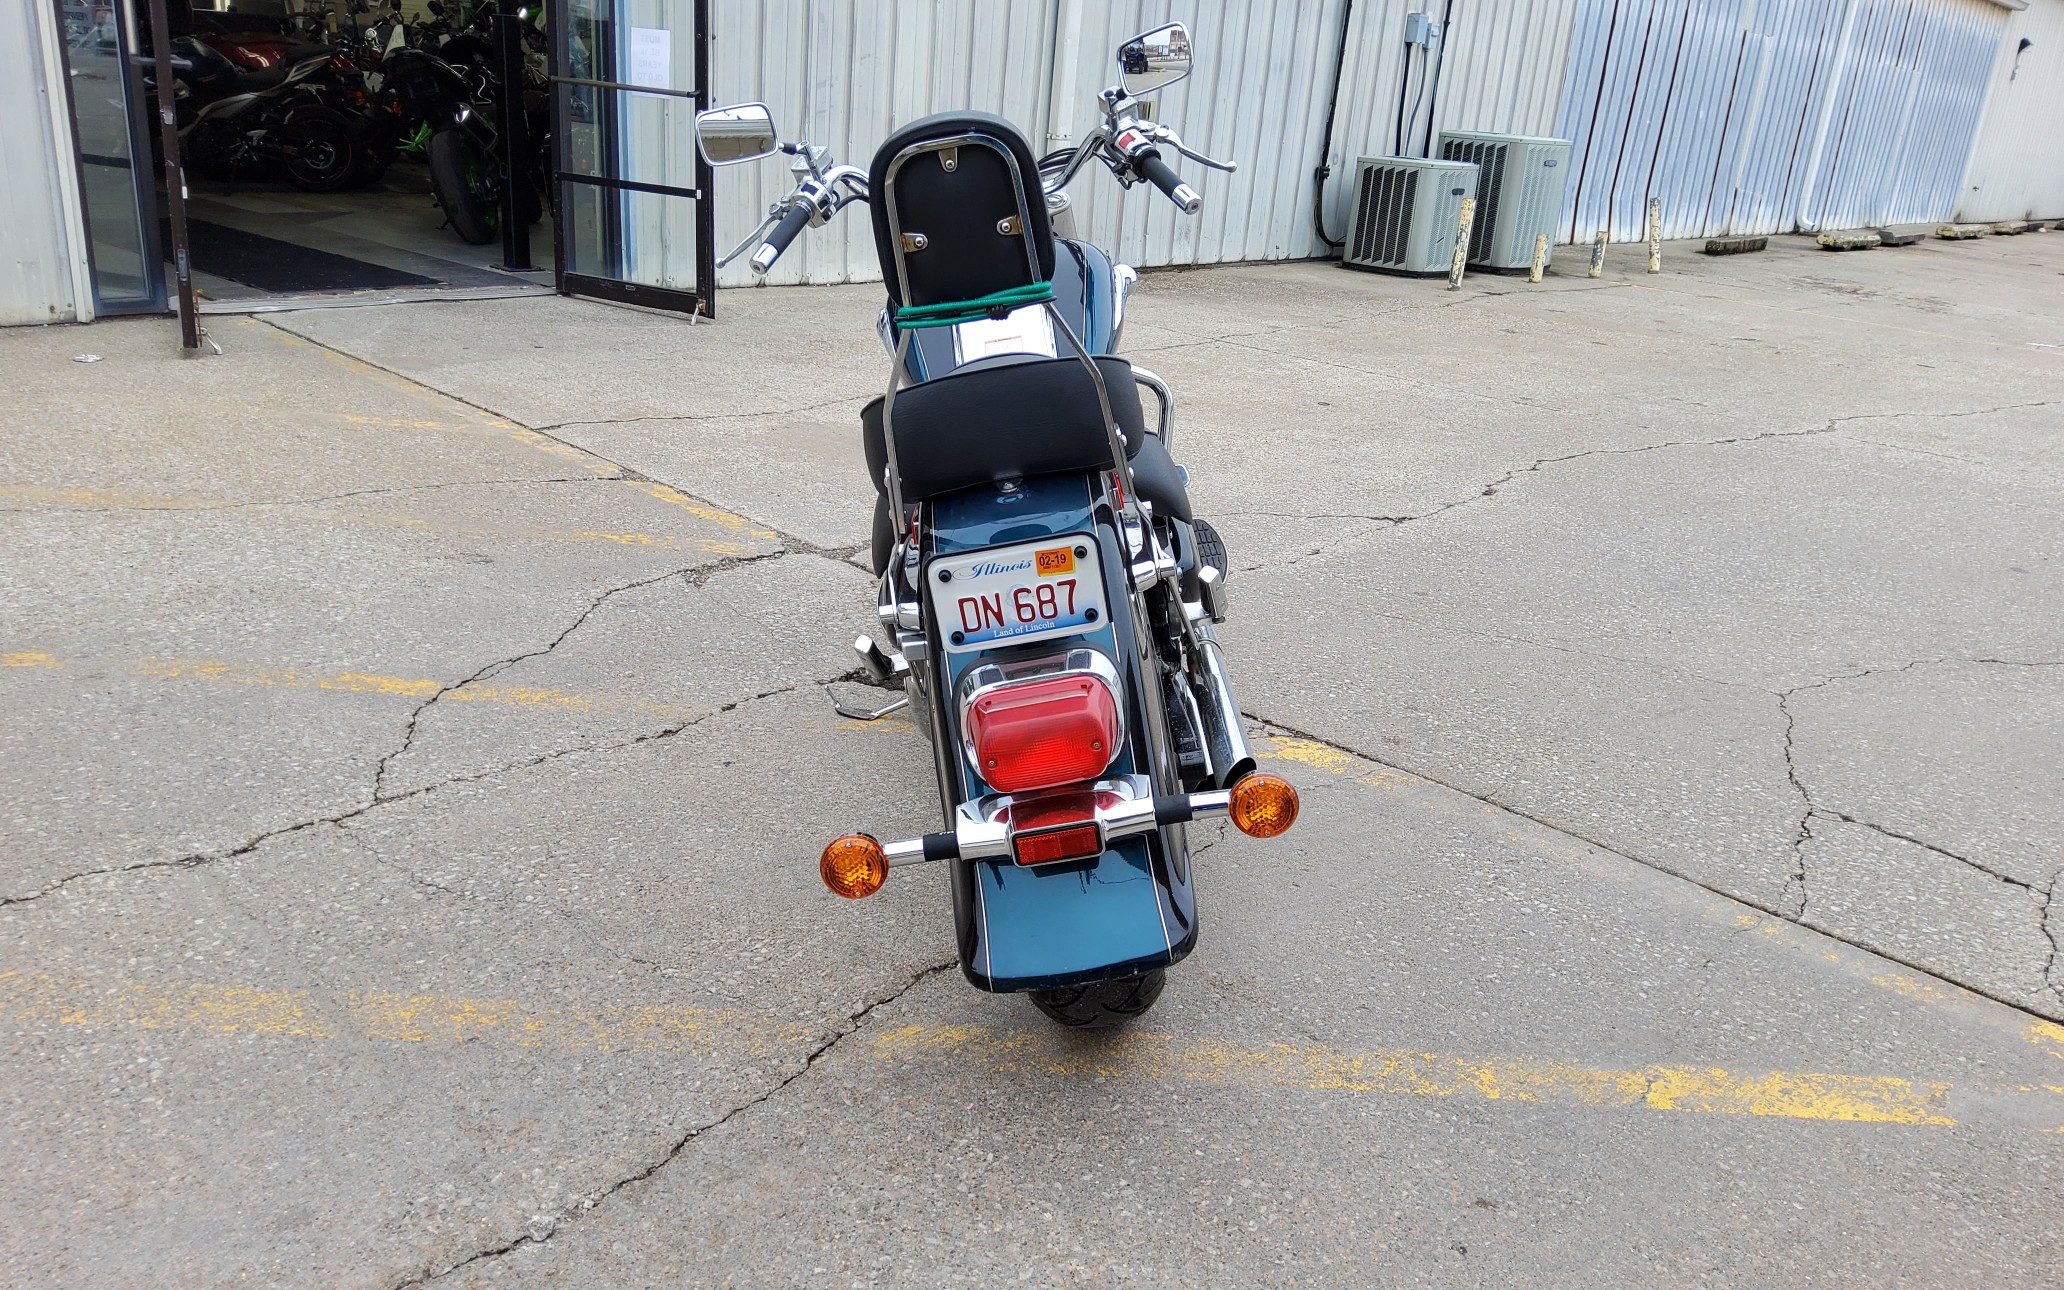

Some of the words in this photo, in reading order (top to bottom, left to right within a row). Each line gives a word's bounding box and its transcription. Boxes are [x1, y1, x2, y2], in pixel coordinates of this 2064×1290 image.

[1039, 553, 1067, 566] 02-19
[952, 560, 1032, 580] Illinois
[957, 592, 1005, 633] DN
[1013, 578, 1077, 623] 687
[993, 629, 1014, 638] Land
[1014, 626, 1024, 635] of
[1024, 620, 1056, 632] Lincoln
